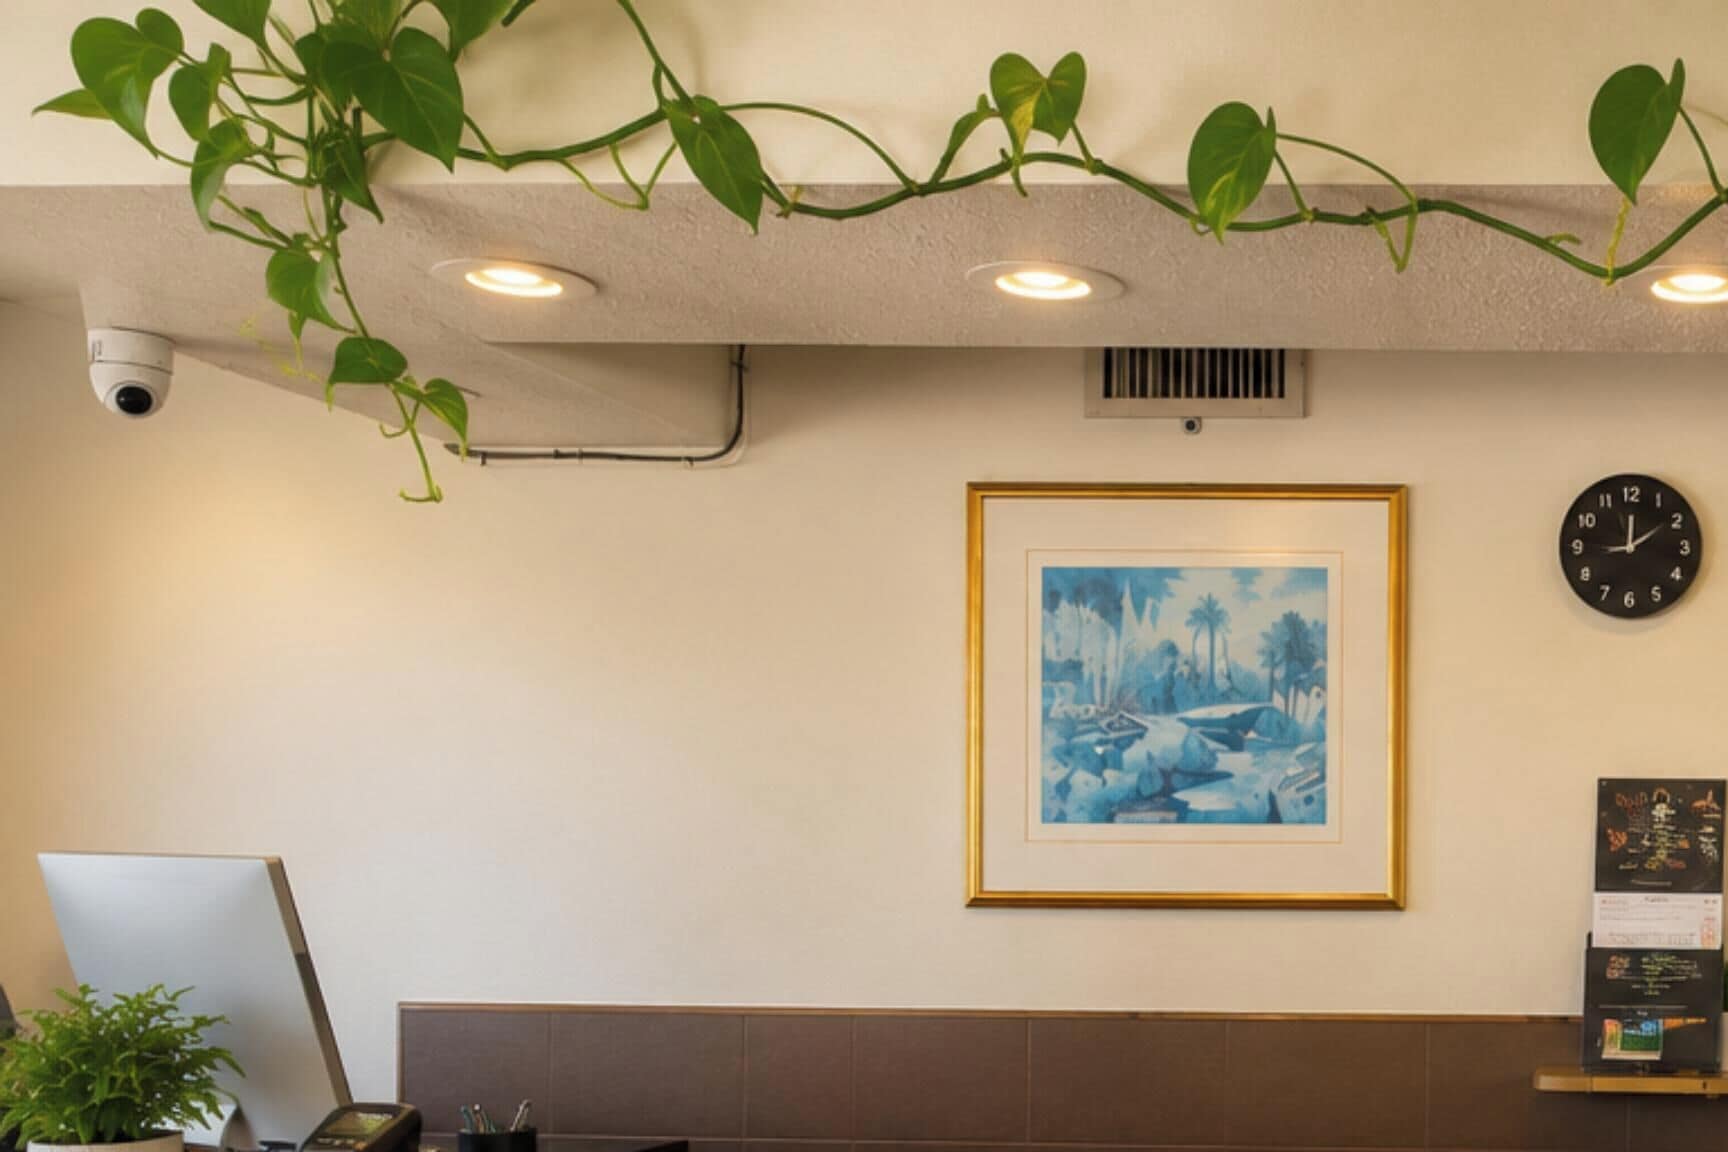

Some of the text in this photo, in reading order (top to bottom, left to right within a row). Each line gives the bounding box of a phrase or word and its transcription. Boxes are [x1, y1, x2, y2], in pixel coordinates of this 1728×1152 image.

[1599, 493, 1612, 509] 11
[1623, 486, 1640, 503] 12
[1656, 492, 1662, 508] 1
[1578, 513, 1596, 528] 10
[1671, 512, 1683, 529] 2
[1571, 539, 1584, 555] 9
[1680, 540, 1690, 556] 3
[1580, 566, 1591, 581] 8
[1670, 566, 1682, 580] 4
[1600, 585, 1610, 601] 7
[1624, 591, 1635, 608] 6
[1651, 586, 1661, 602] 5
